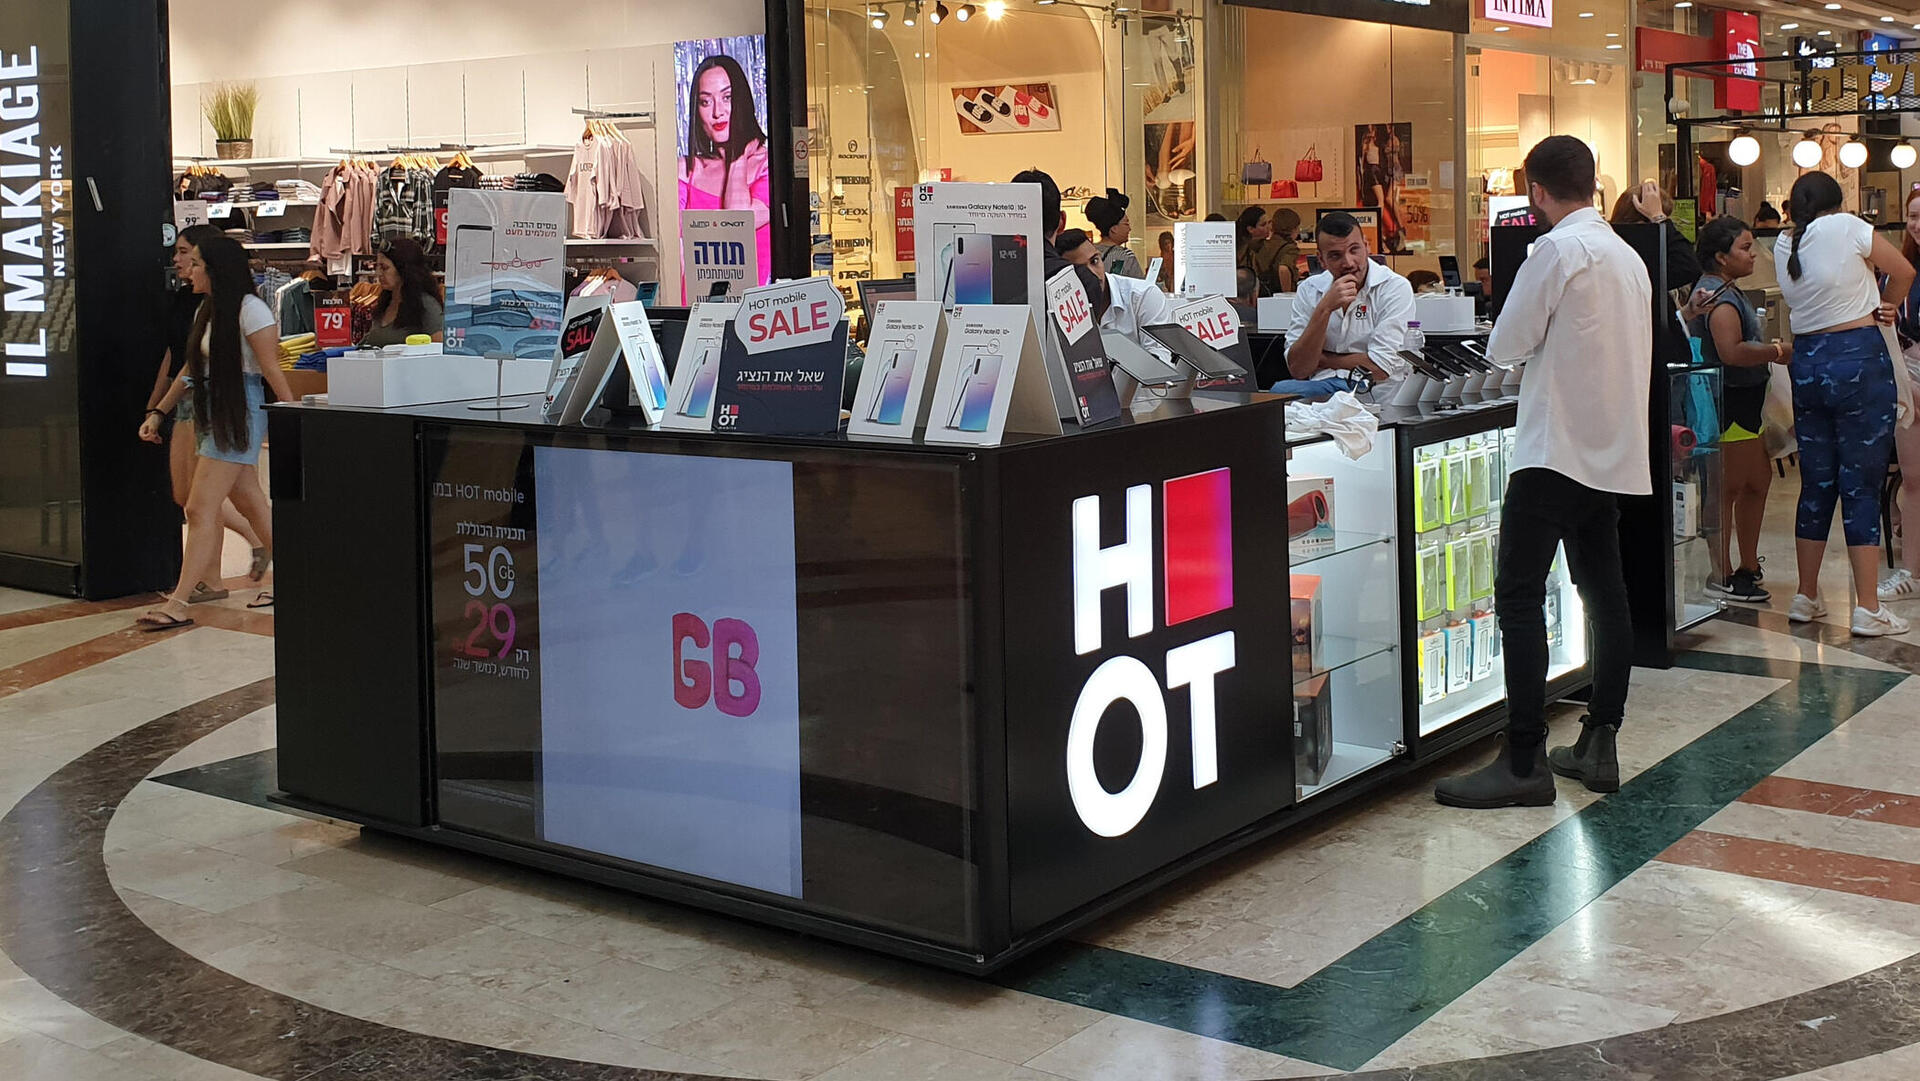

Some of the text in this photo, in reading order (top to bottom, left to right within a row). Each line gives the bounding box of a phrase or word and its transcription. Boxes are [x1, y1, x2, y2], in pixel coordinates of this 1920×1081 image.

[0, 45, 47, 377] IL MAKIAGE
[50, 144, 66, 277] NEW YORK
[838, 208, 868, 216] GEOX
[694, 241, 746, 266] תודה
[696, 268, 744, 280] שהשתתפתן
[749, 298, 770, 311] HOT
[772, 291, 808, 306] mobile
[1059, 289, 1088, 334] SALE
[321, 312, 344, 329] 79
[748, 300, 830, 342] SALE
[1179, 306, 1214, 324] HOT mobile
[736, 369, 824, 382] שאל את הנציג
[456, 484, 480, 500] HOT
[484, 488, 524, 504] mobile
[456, 520, 526, 541] תכנית הכוללת
[463, 543, 514, 599] 50
[464, 600, 516, 659] 29
[516, 648, 530, 664] רק
[672, 612, 762, 718] GB
[452, 658, 530, 680] לחודש, למשך שנה
